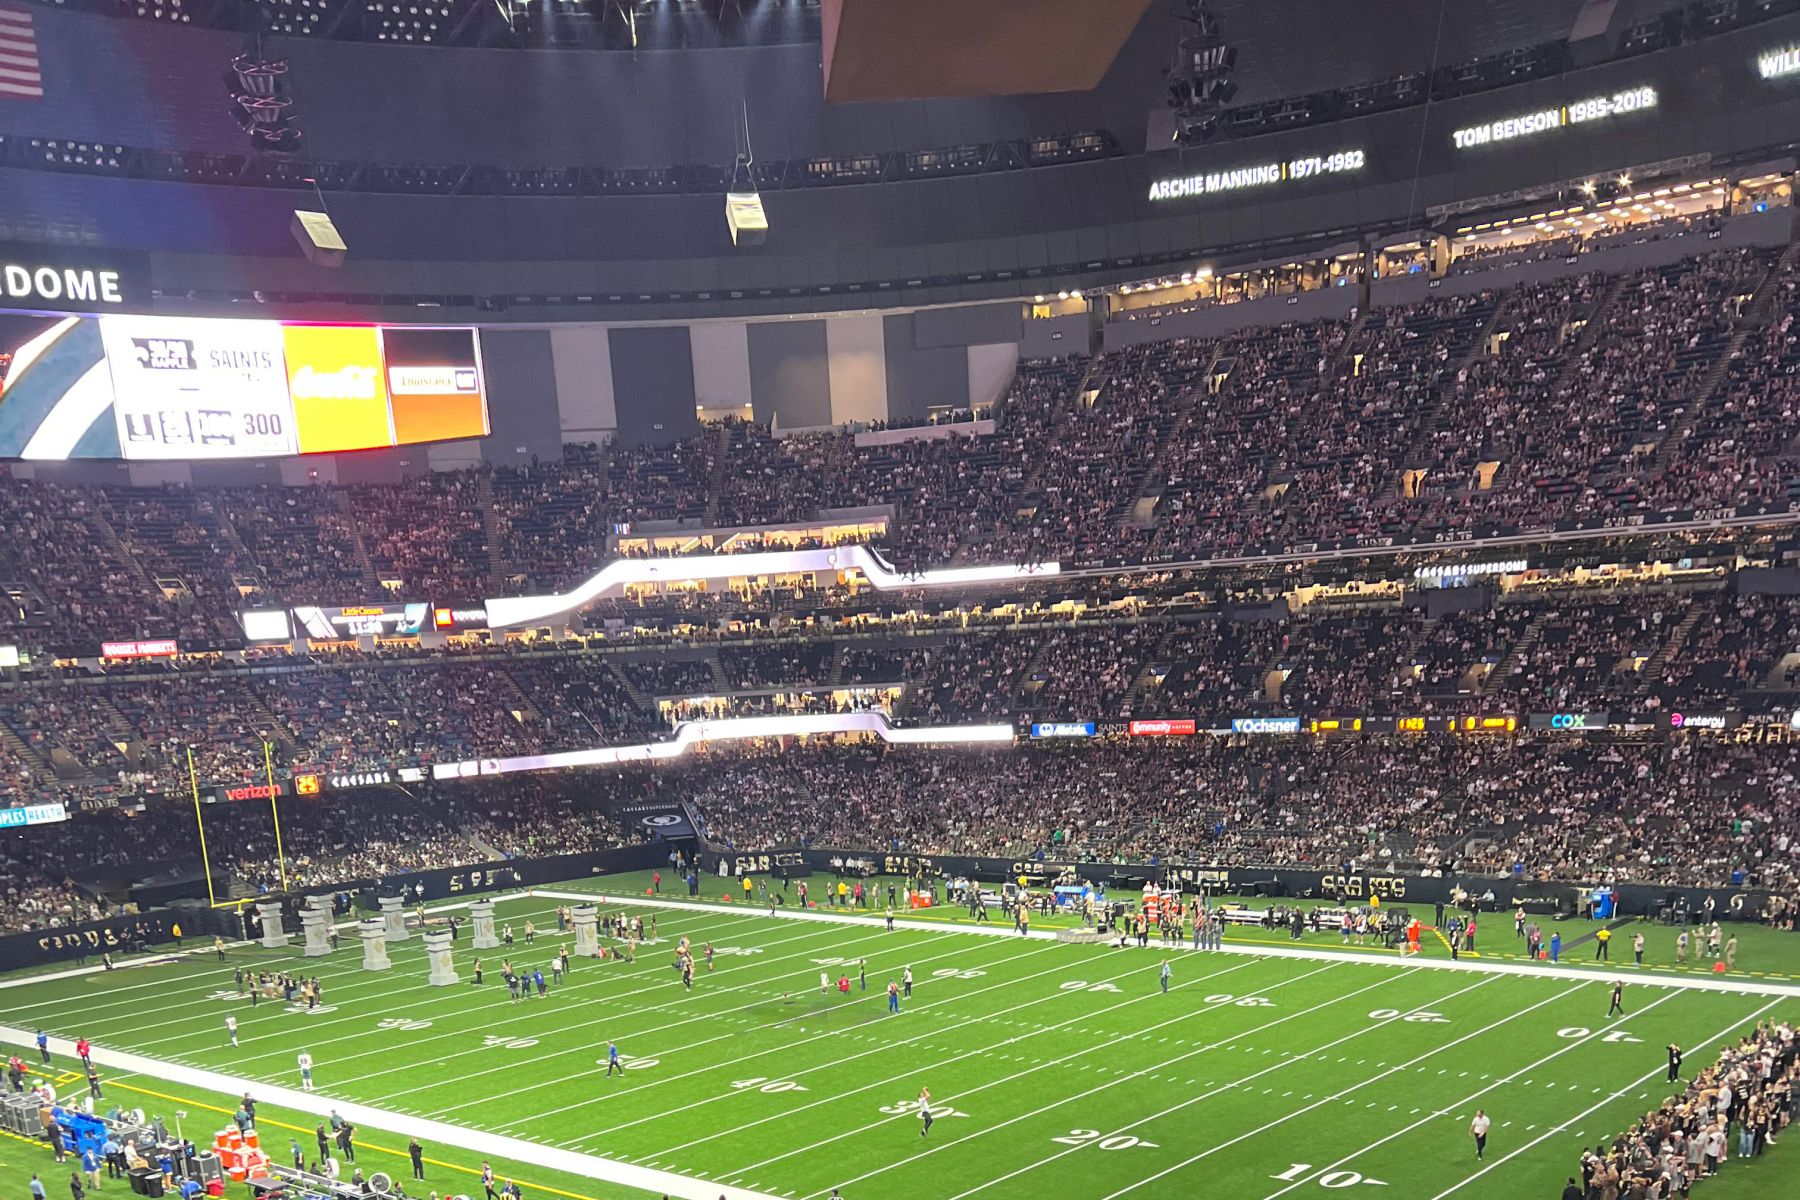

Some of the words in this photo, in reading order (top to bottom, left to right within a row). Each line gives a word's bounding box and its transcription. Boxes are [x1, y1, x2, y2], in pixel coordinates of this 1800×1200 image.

[1453, 128, 1490, 149] TOM
[1491, 109, 1559, 141] BENSON
[1568, 87, 1658, 123] 1985-2018
[1149, 176, 1205, 200] ARCHIE
[1205, 163, 1280, 192] MANNING
[1288, 150, 1364, 179] 1971-1982
[0, 265, 122, 302] DOME
[210, 350, 272, 369] SAINTS
[243, 413, 282, 436] 300
[1467, 560, 1528, 575] SUPERDOME
[452, 609, 488, 622] TOYOTA
[1098, 723, 1128, 733] SAINTS
[1133, 721, 1172, 734] Community
[1242, 719, 1297, 732] Ochsner
[1551, 714, 1585, 728] COX
[1684, 714, 1726, 729] entergy
[331, 772, 391, 788] CAESARS
[225, 783, 282, 801] verizon
[0, 811, 26, 825] PLES
[1368, 1009, 1443, 1023] 20
[1556, 1027, 1632, 1042] 10
[730, 1077, 797, 1093] 40
[1051, 1129, 1140, 1150] 20
[1268, 1163, 1363, 1188] 10
